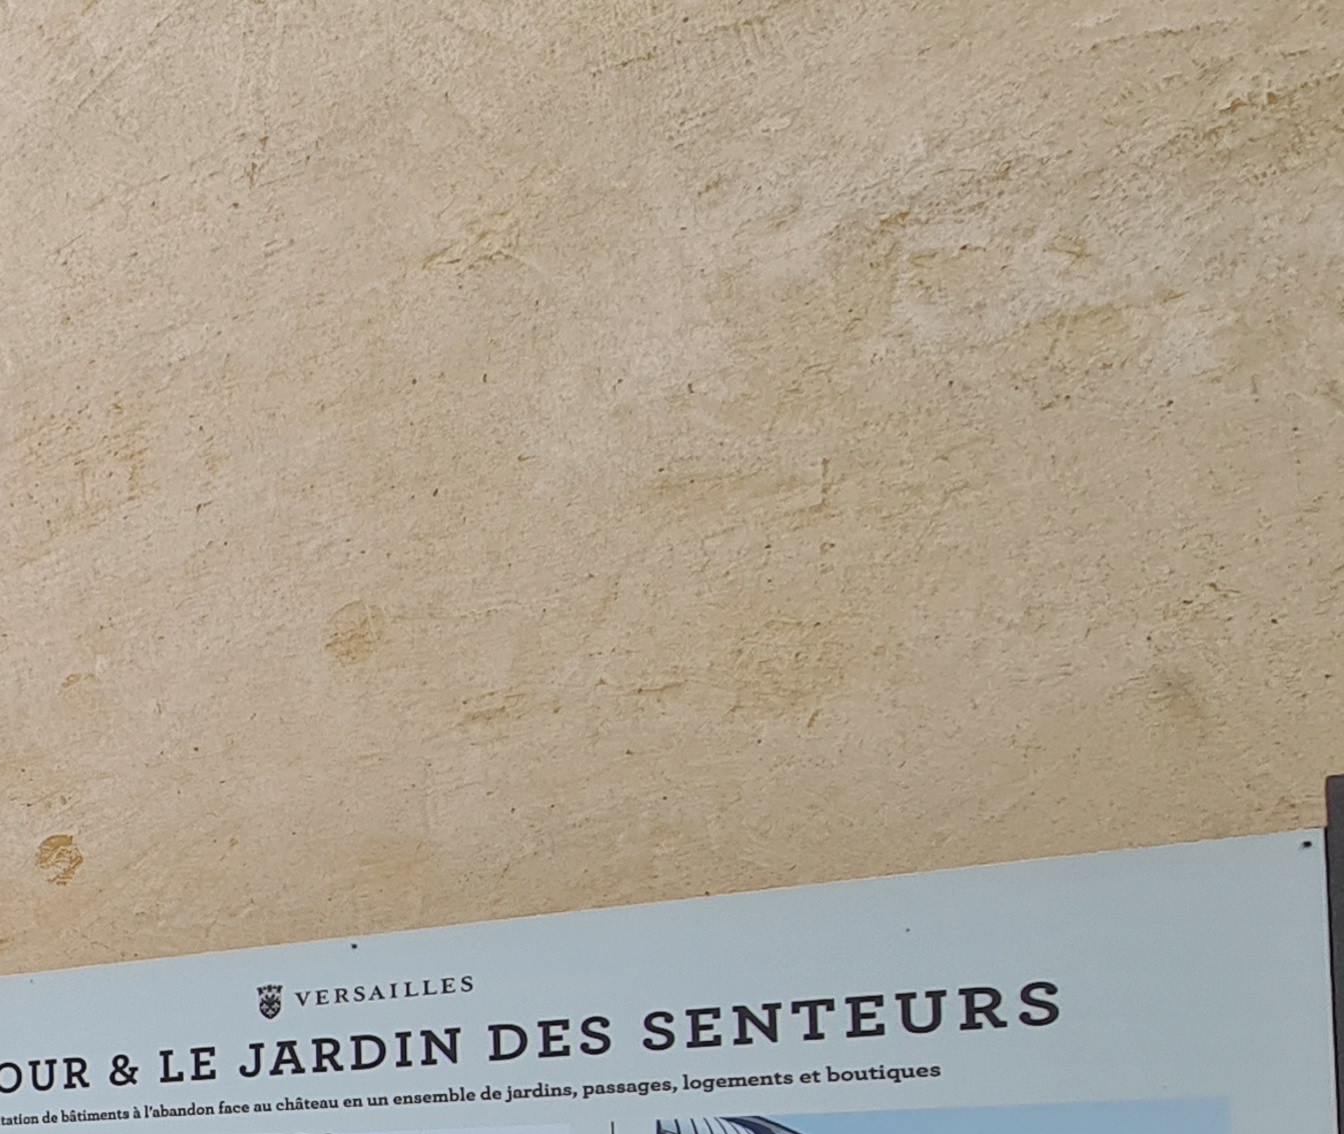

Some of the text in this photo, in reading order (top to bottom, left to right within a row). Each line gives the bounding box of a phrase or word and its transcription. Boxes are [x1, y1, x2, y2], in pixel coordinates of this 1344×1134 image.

[293, 975, 474, 1007] VERSAILLES
[108, 1053, 139, 1087] &
[159, 1046, 216, 1083] LE
[239, 1027, 461, 1079] JARDIN
[487, 1016, 611, 1062] DES
[642, 981, 1060, 1051] SENTEURS
[42, 1111, 58, 1124] de
[61, 1108, 130, 1122] bâtiments
[133, 1107, 141, 1119] à
[144, 1102, 215, 1118] l'abandon
[219, 1100, 250, 1114] face
[253, 1101, 272, 1113] au
[275, 1095, 339, 1111] château
[343, 1096, 363, 1108] en
[367, 1095, 389, 1107] un
[393, 1087, 476, 1105] ensemble
[480, 1085, 502, 1100] de
[505, 1082, 577, 1102] jardins,
[582, 1078, 677, 1099] passages,
[682, 1071, 794, 1093] logements
[799, 1068, 821, 1084] et
[826, 1063, 941, 1083] boutiques
